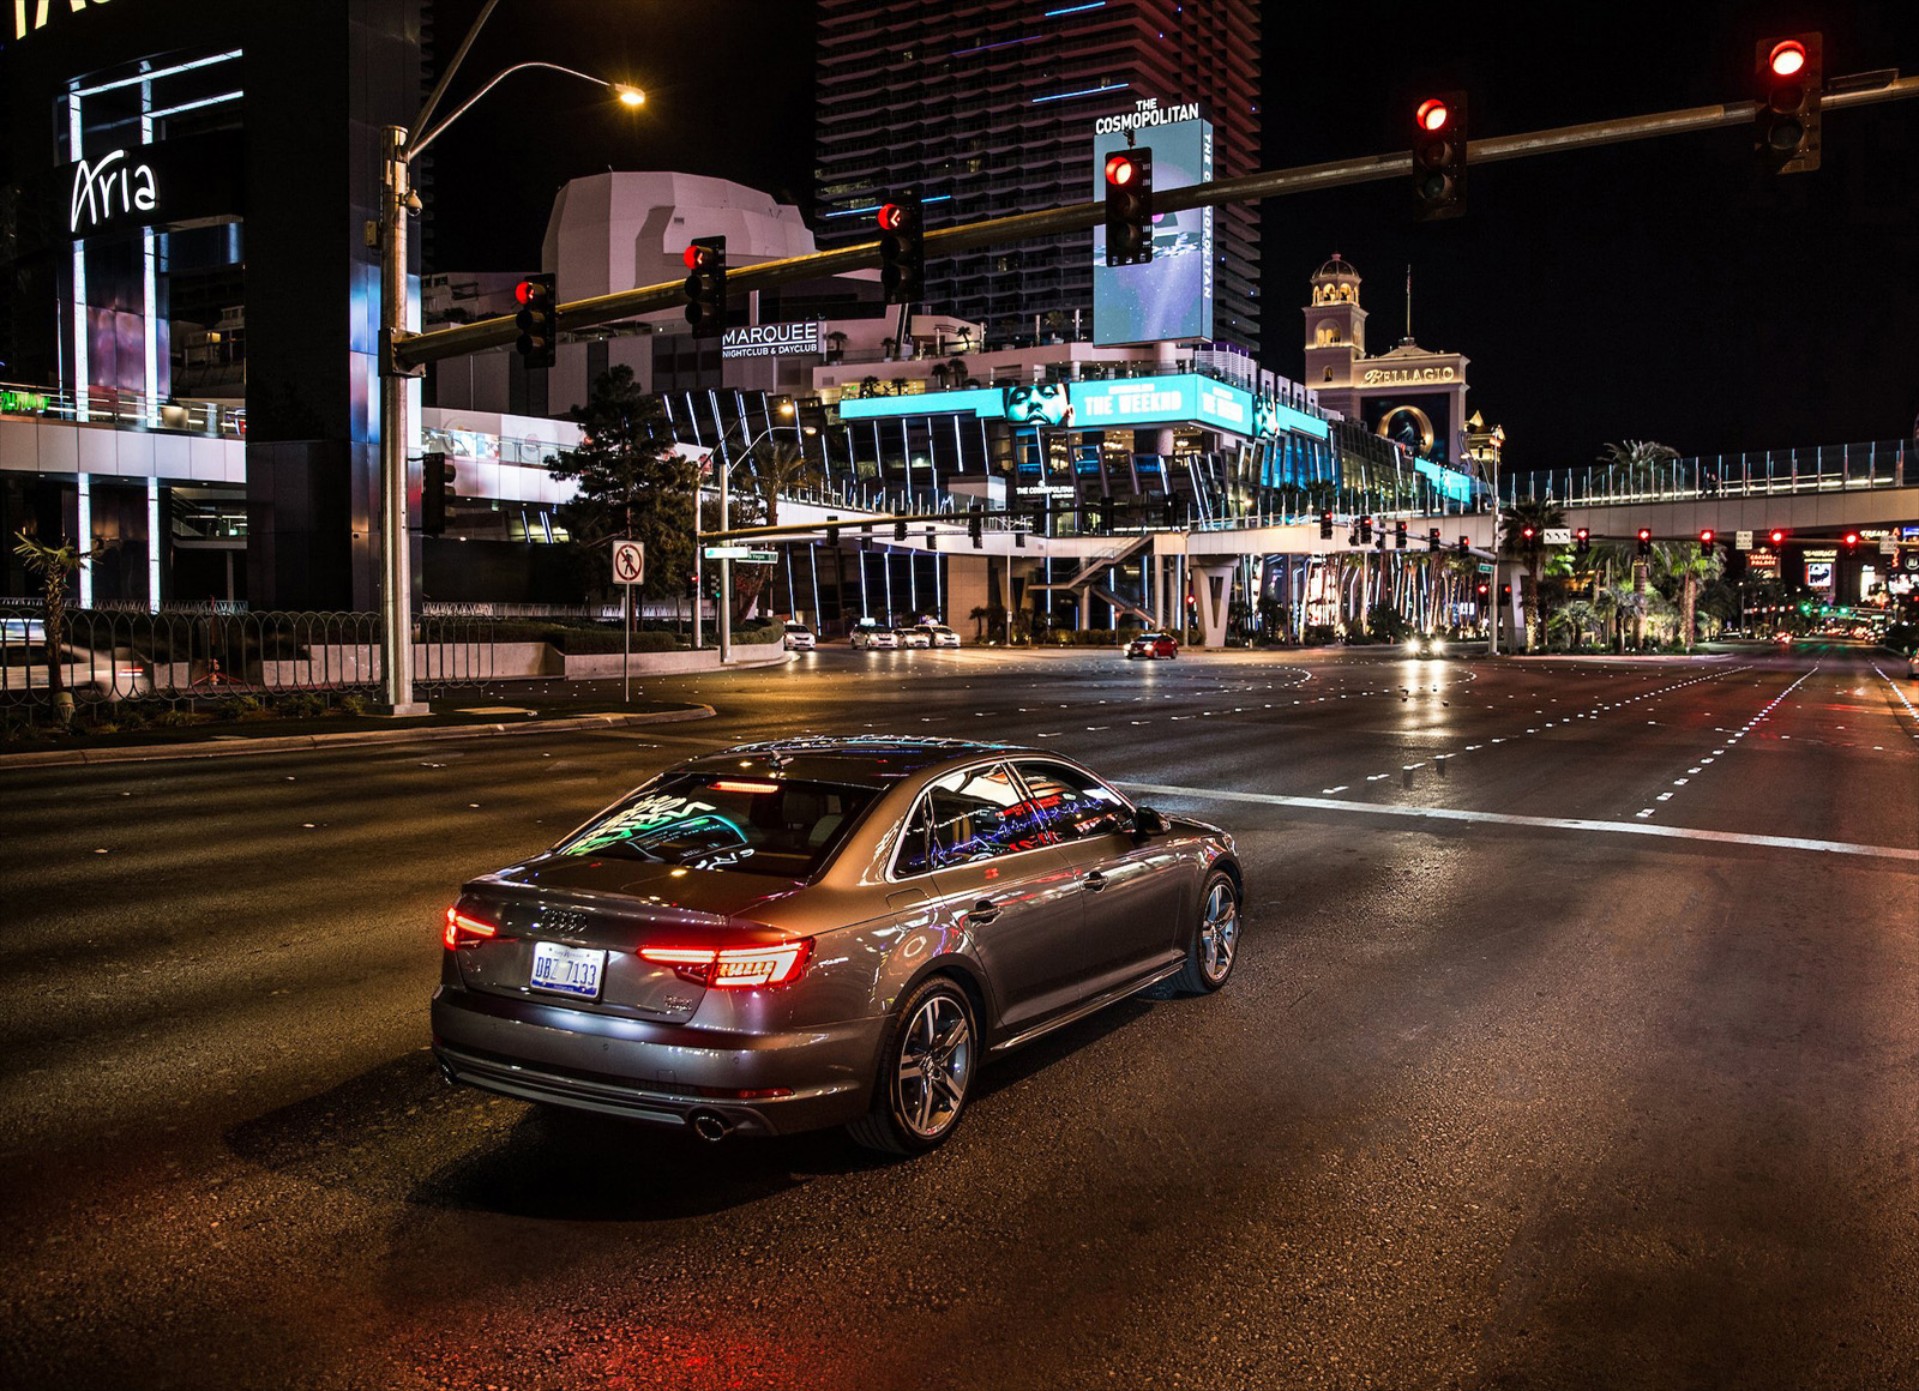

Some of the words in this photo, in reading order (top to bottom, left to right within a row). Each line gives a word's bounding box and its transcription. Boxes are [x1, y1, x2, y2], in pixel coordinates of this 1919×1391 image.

[1135, 97, 1157, 112] THE
[1095, 102, 1199, 135] COSMOPOLITAN
[1203, 134, 1212, 165] THE
[70, 149, 156, 233] Aria
[722, 322, 817, 346] MARQUEE
[722, 347, 769, 359] NIGHTCLUB
[770, 346, 777, 355] &
[778, 343, 818, 354] DAYCLUB
[1084, 395, 1113, 416] THE
[535, 956, 559, 980] DBZ
[565, 960, 597, 986] 7133
